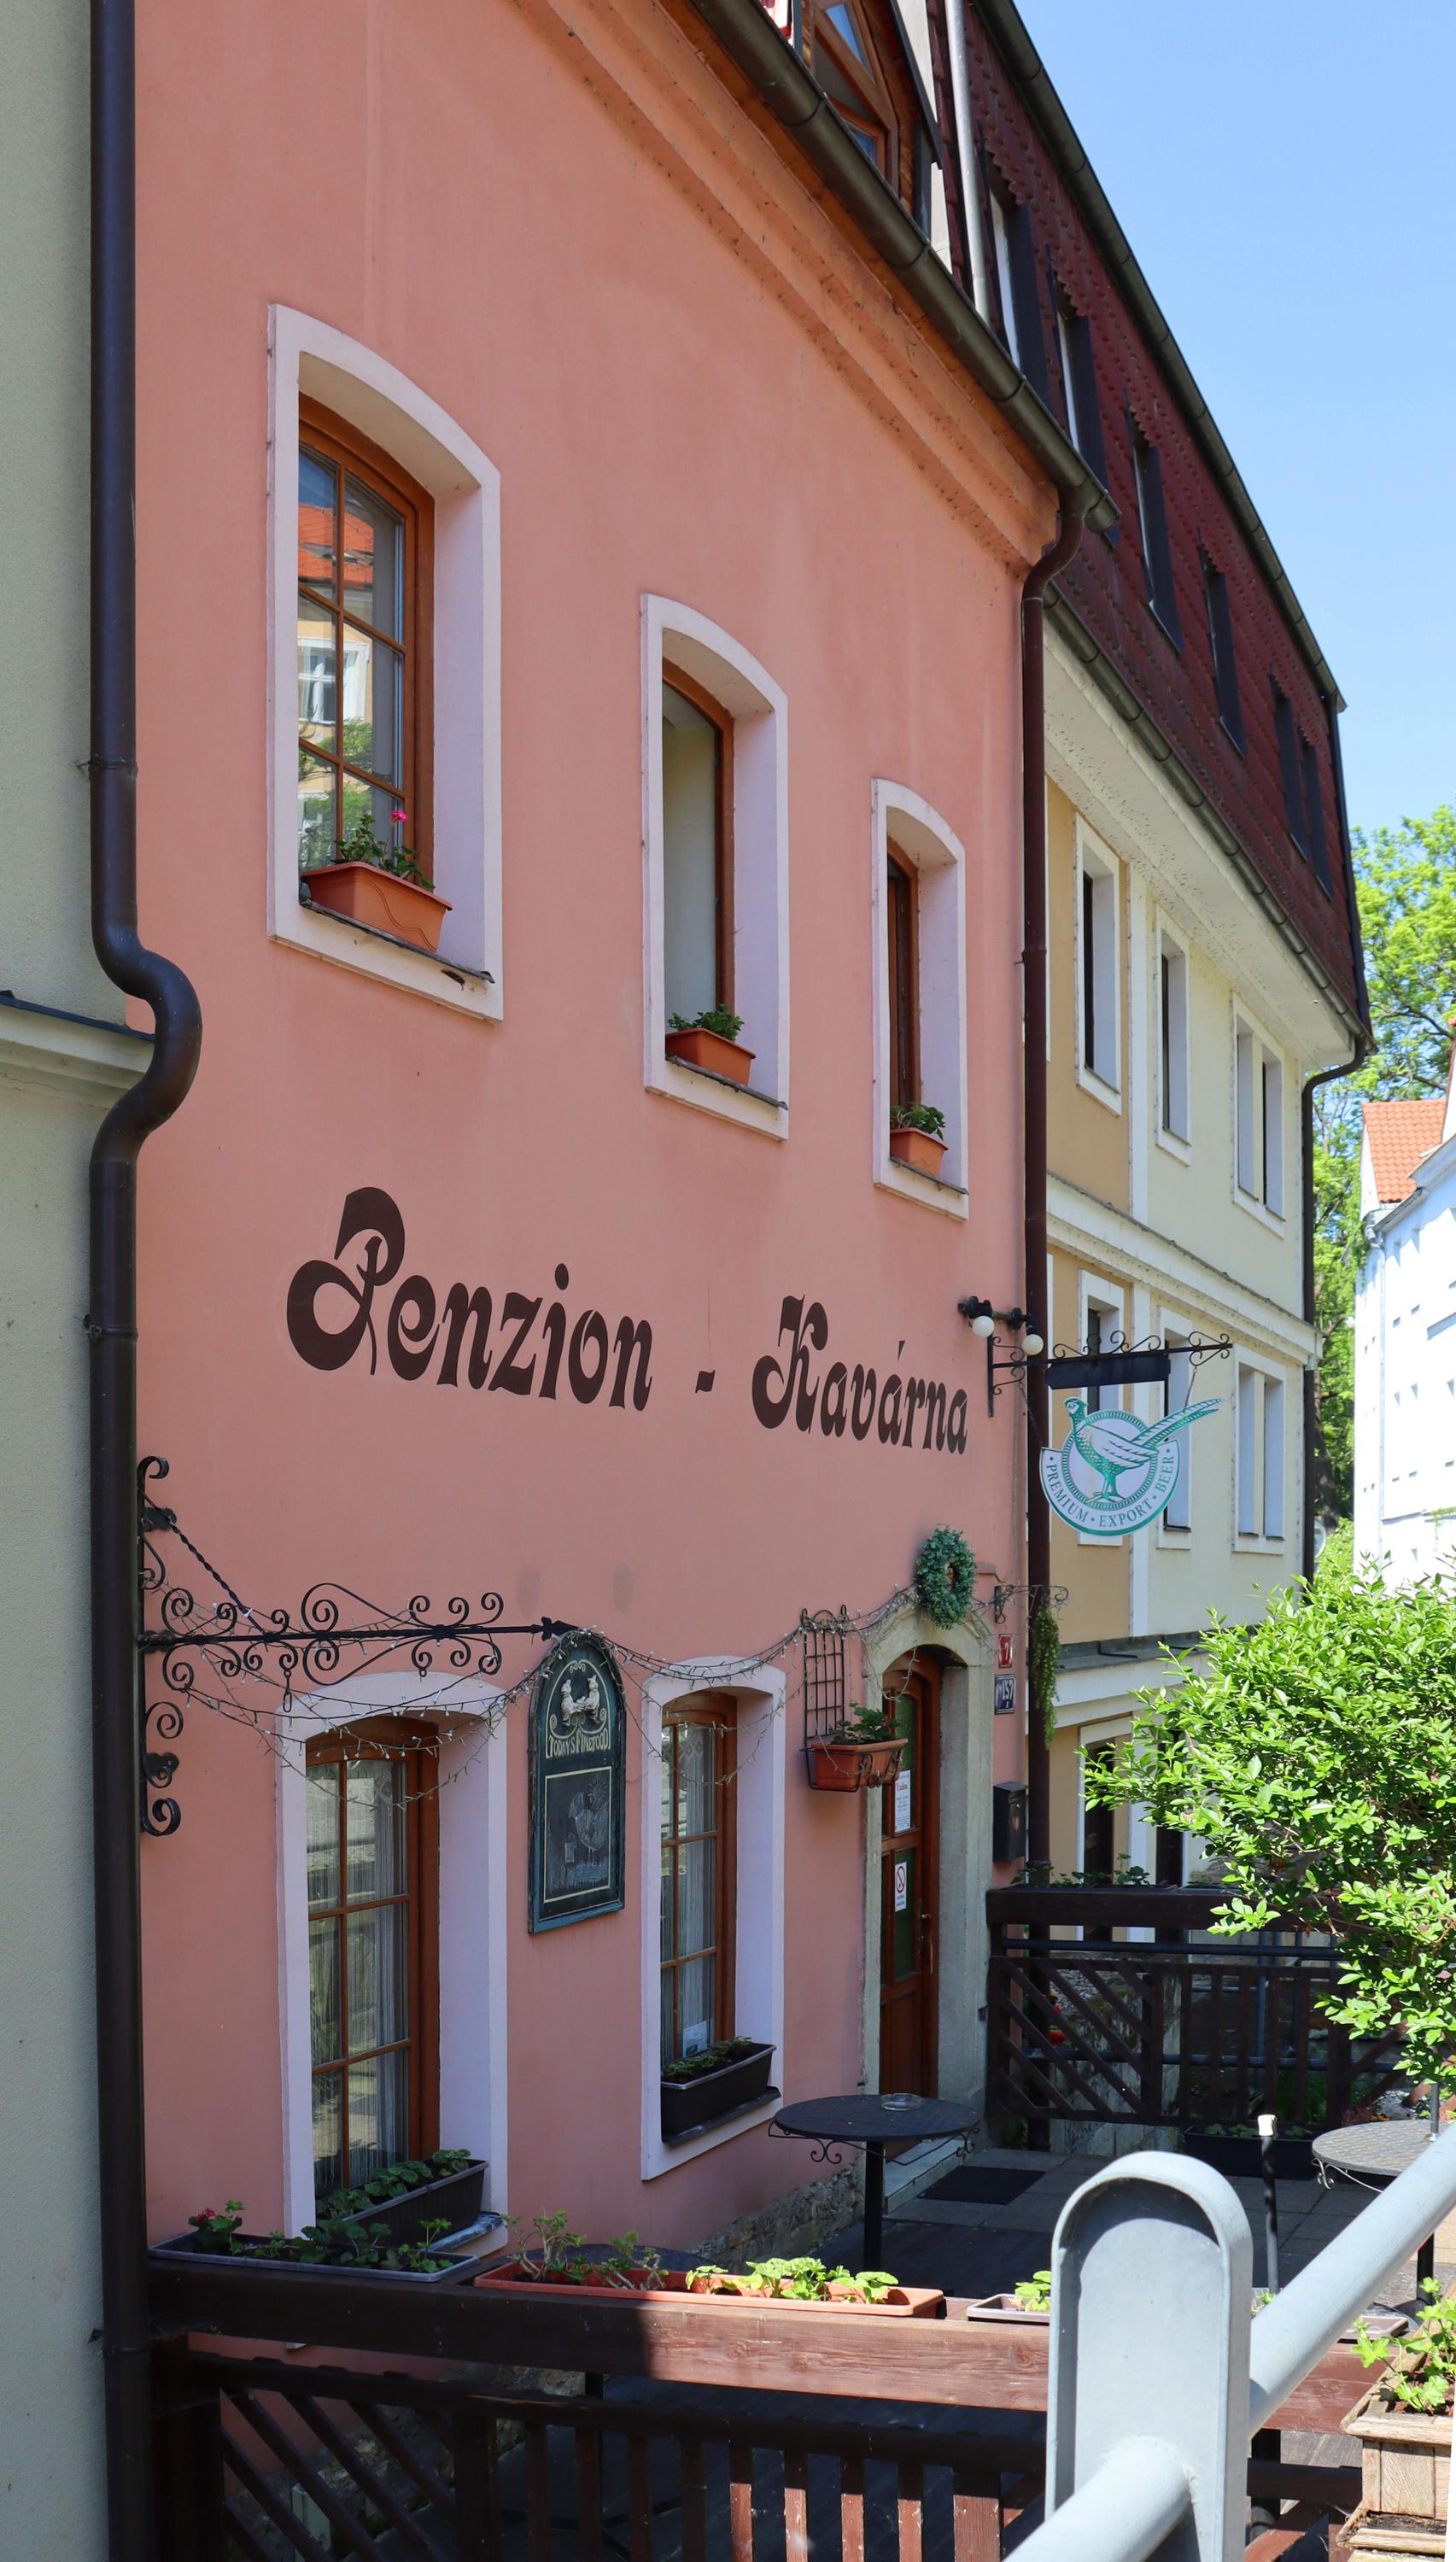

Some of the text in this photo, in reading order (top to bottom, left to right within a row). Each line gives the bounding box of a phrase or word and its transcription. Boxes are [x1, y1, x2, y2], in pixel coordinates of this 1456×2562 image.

[286, 1186, 653, 1412] Penzion
[751, 1293, 968, 1455] Kavárna
[1046, 1455, 1175, 1528] PREMIUM EXPORT BEER
